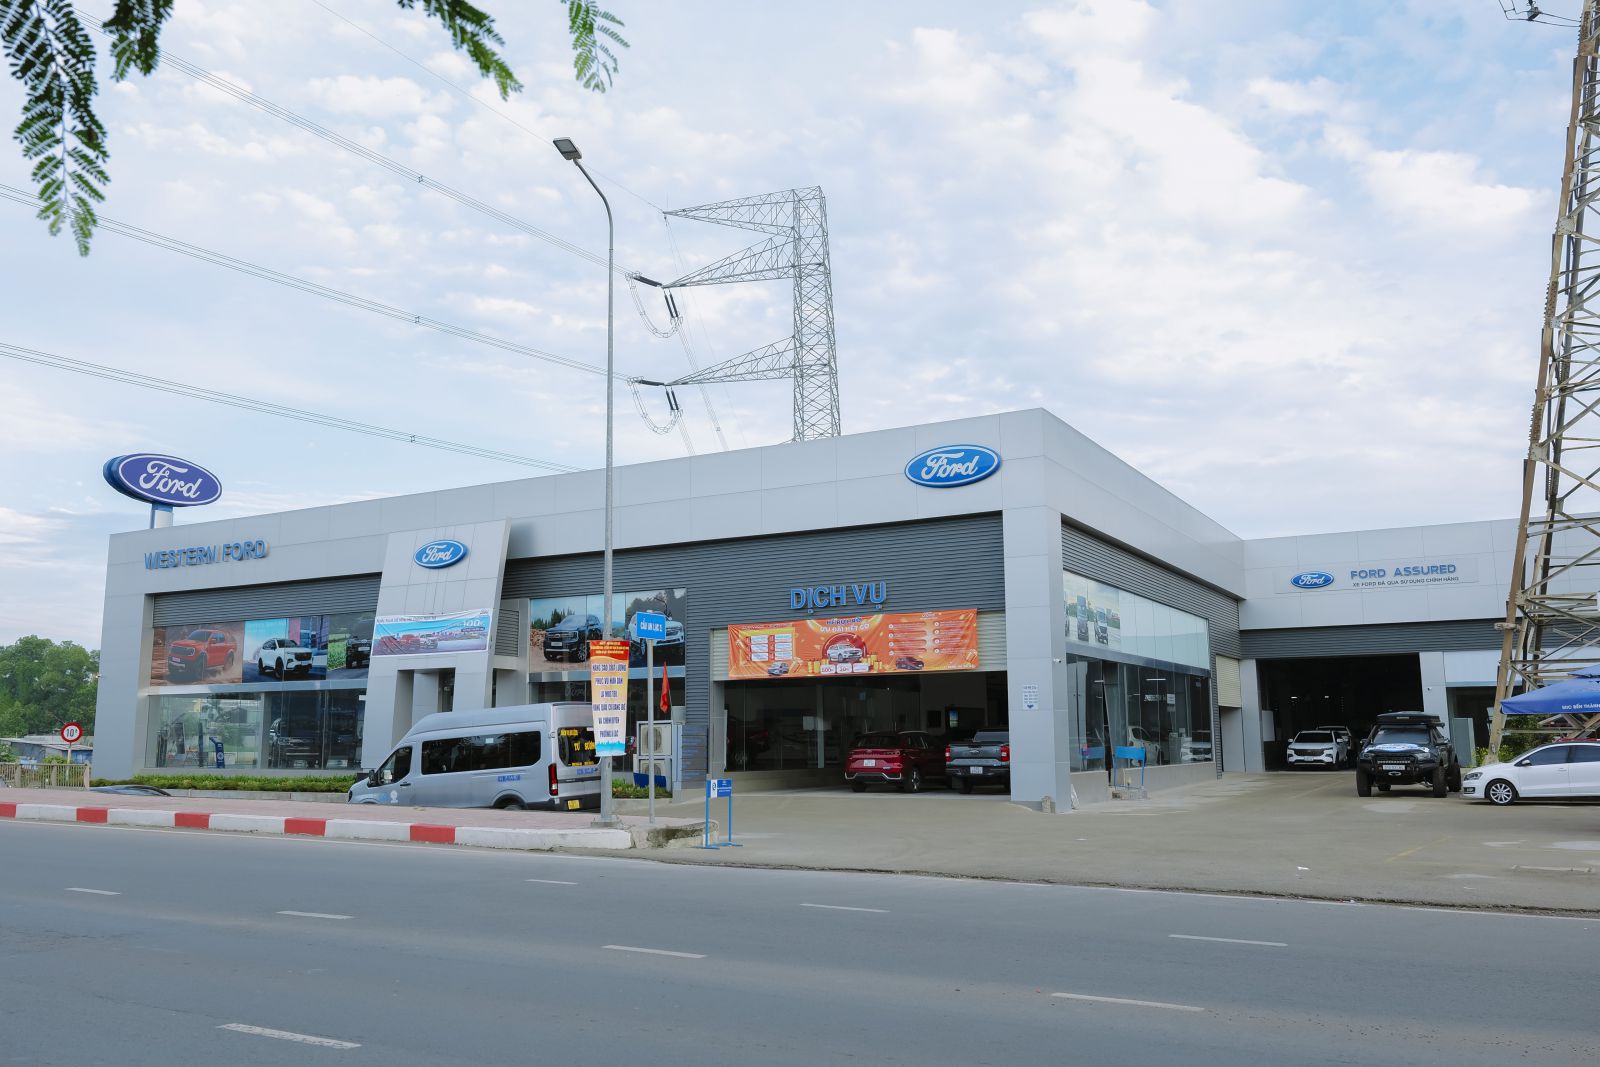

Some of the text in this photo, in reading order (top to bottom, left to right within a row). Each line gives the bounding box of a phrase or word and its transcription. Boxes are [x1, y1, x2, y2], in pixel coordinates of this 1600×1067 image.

[139, 460, 203, 499] Ford
[921, 452, 980, 480] Ford
[144, 540, 267, 570] WESTERN FORD
[422, 544, 454, 563] Ford
[1298, 573, 1325, 586] Ford
[1350, 564, 1457, 579] FORD ASSURED
[790, 581, 887, 614] DỊCH VỤ
